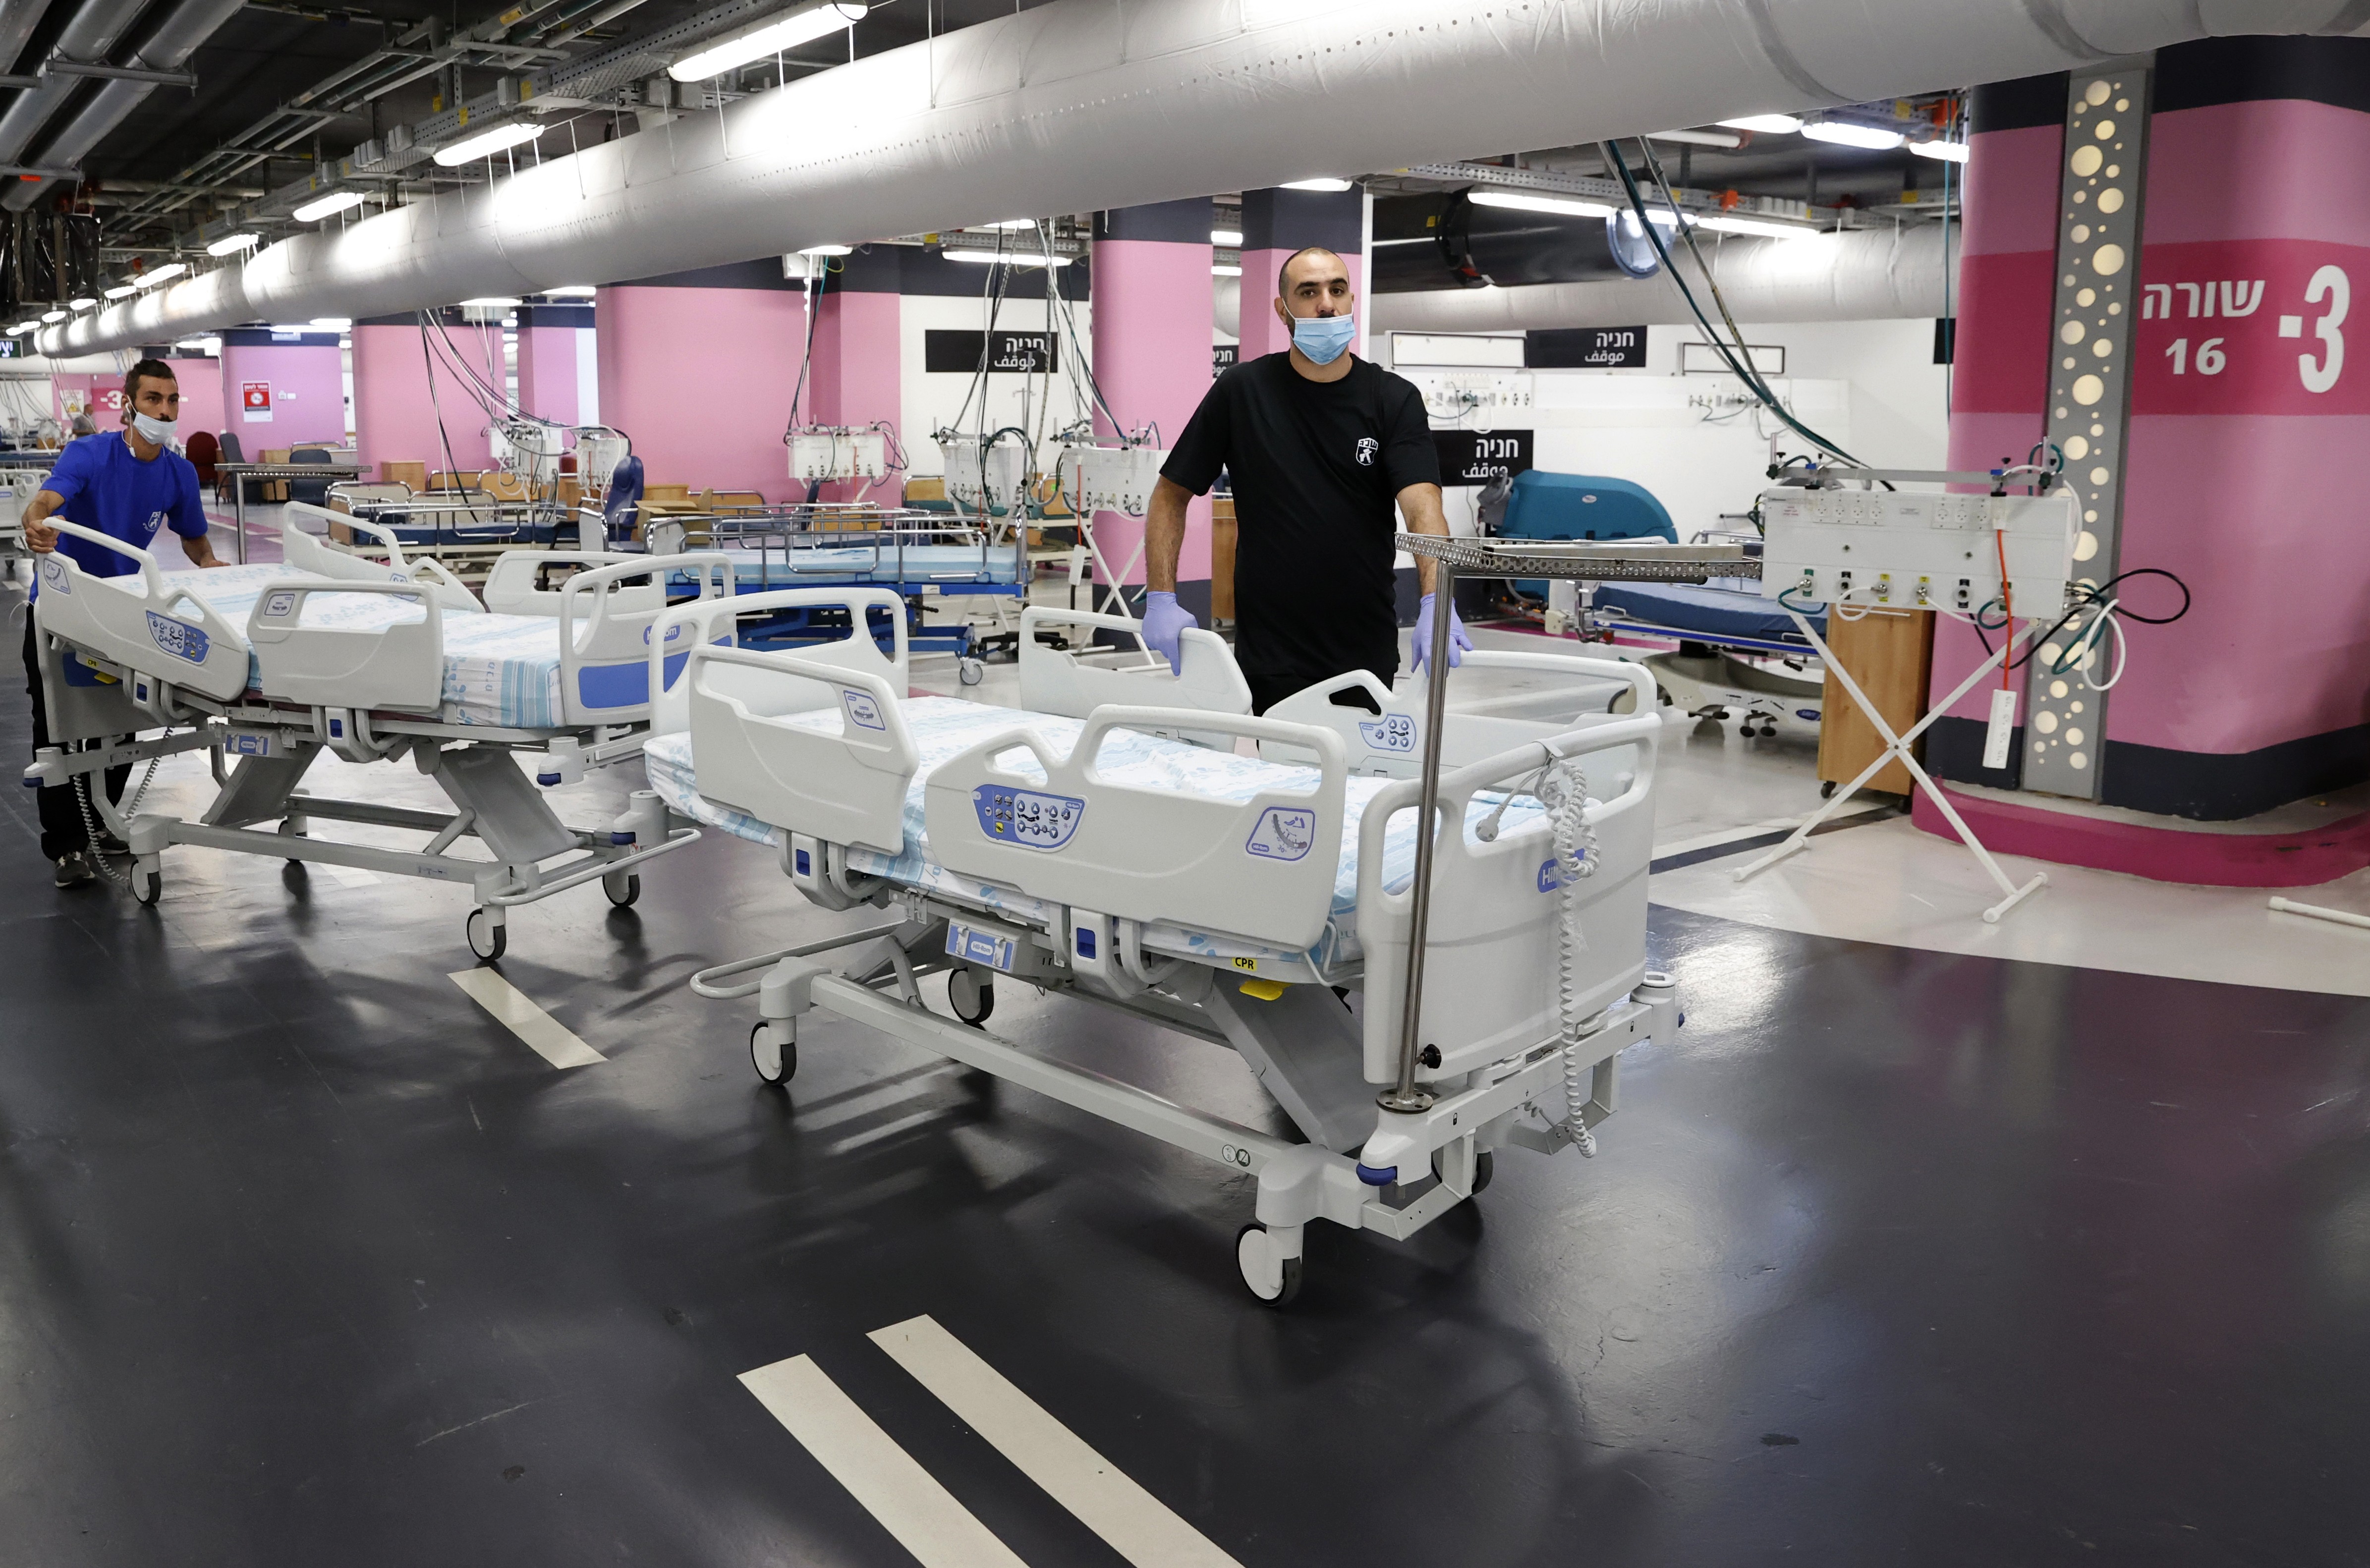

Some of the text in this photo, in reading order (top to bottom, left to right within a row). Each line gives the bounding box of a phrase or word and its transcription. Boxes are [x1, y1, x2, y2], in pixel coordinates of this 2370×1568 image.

[2143, 280, 2265, 319] שורה
[2278, 265, 2351, 393] -3
[1006, 337, 1045, 352] חניה
[1596, 332, 1635, 347] חניה
[0, 341, 13, 357] יצ
[2165, 338, 2226, 375] 16
[1584, 350, 1625, 365] موقف
[1476, 439, 1519, 458] חניה
[1235, 957, 1254, 970] CPR
